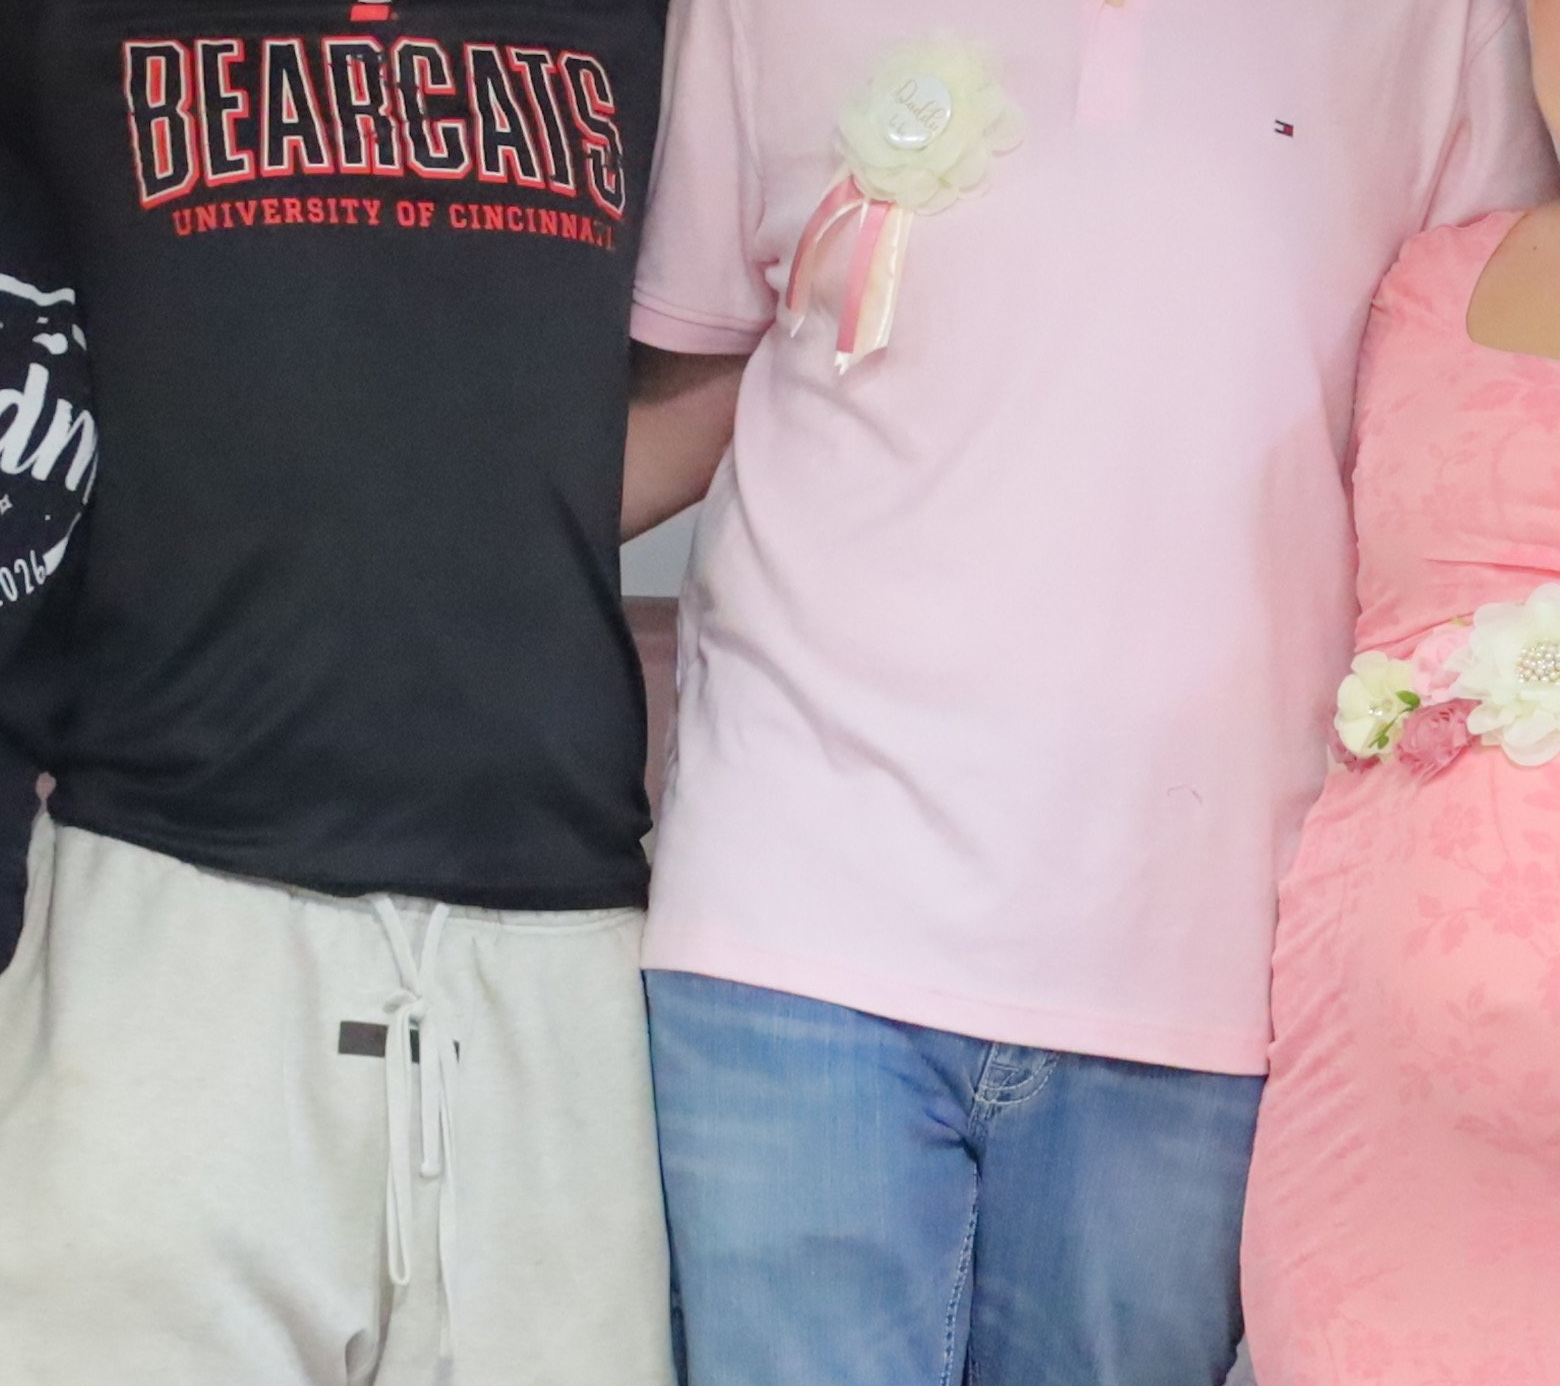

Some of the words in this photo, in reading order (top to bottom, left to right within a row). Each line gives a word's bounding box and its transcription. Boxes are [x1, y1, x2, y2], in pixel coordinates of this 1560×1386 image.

[121, 35, 626, 219] BEARCATS
[172, 198, 380, 235] UNIVERSITY
[397, 200, 435, 228] OF
